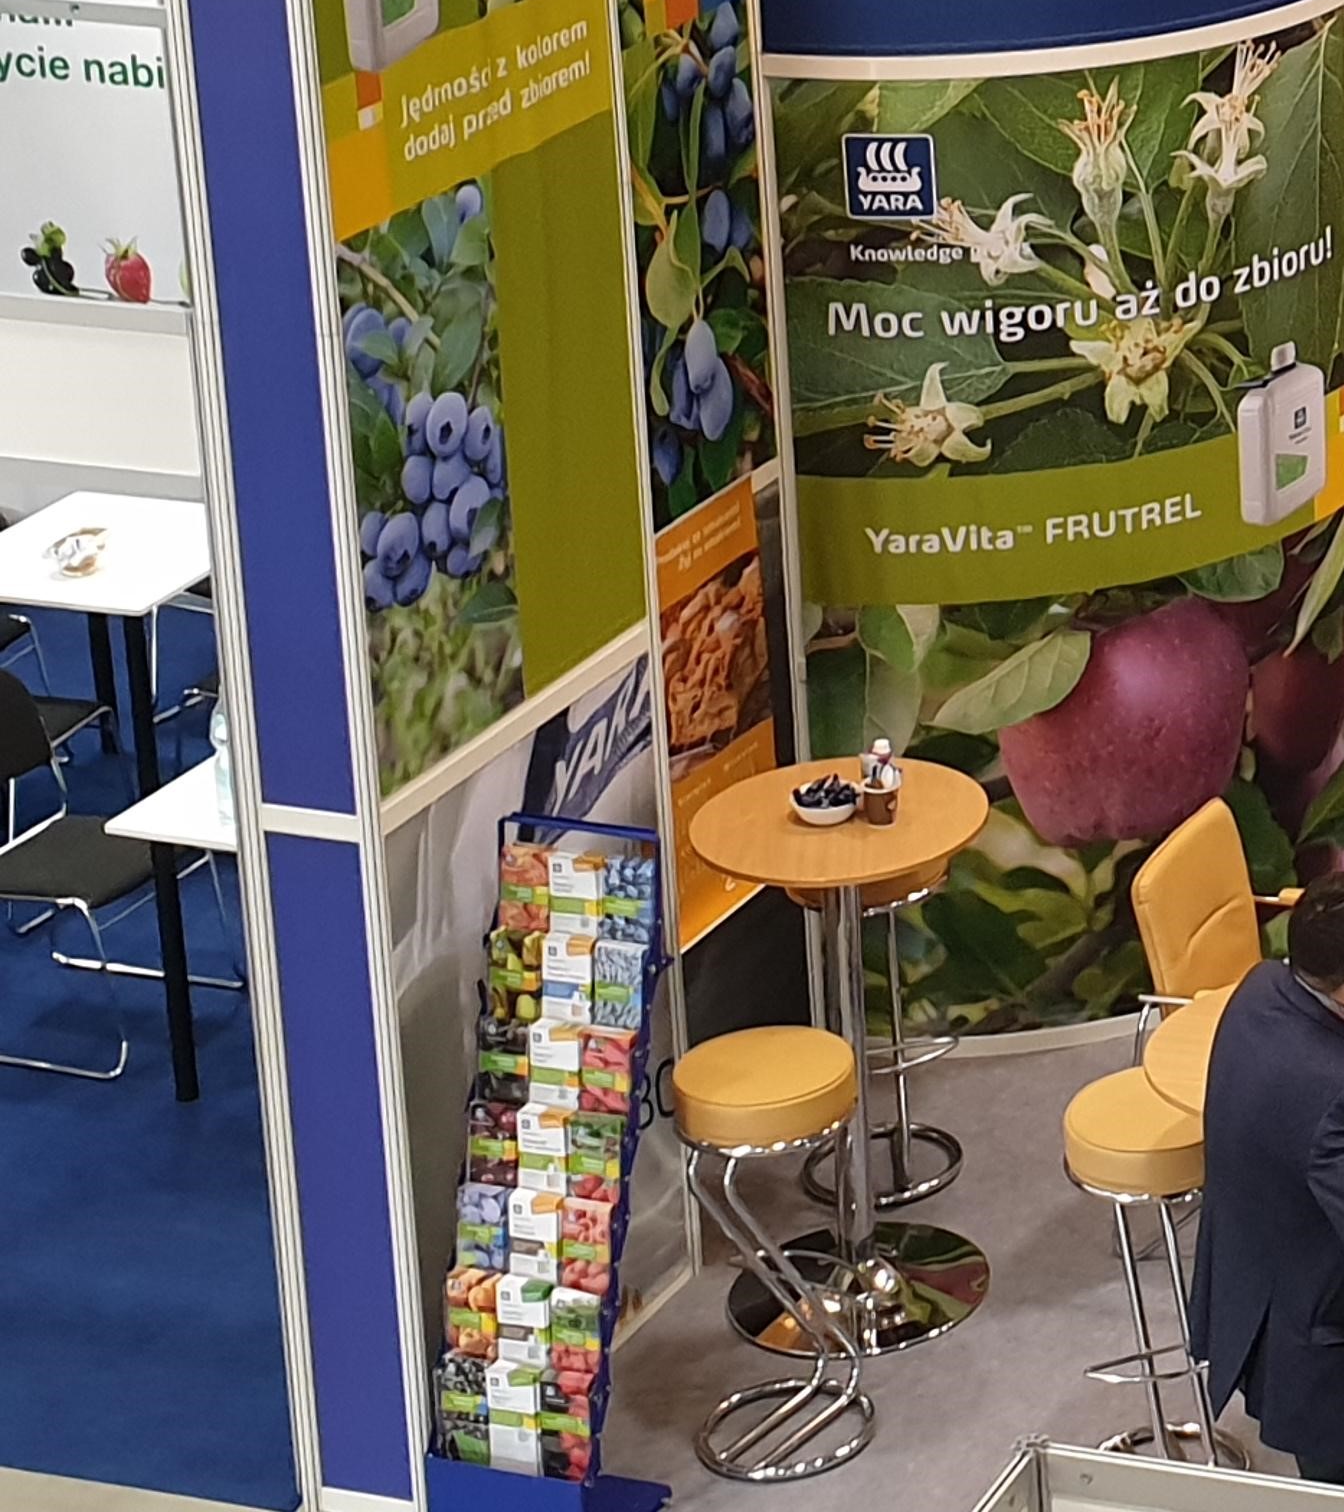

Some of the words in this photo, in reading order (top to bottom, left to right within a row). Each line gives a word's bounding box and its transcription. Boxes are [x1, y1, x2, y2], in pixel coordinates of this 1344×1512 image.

[83, 54, 165, 89] nabi
[496, 55, 508, 77] z
[518, 20, 589, 68] kolorem
[403, 109, 456, 161] dodaj
[463, 93, 512, 140] przed
[520, 53, 591, 110] zbiorem!
[857, 193, 924, 212] YARA
[850, 243, 963, 264] Knowledge
[828, 301, 924, 339] Moc
[941, 297, 1098, 343] wigoru
[1115, 281, 1160, 319] aż
[1174, 272, 1221, 310] do
[1233, 225, 1335, 296] zbioru!
[1044, 493, 1202, 545] FRUTREL
